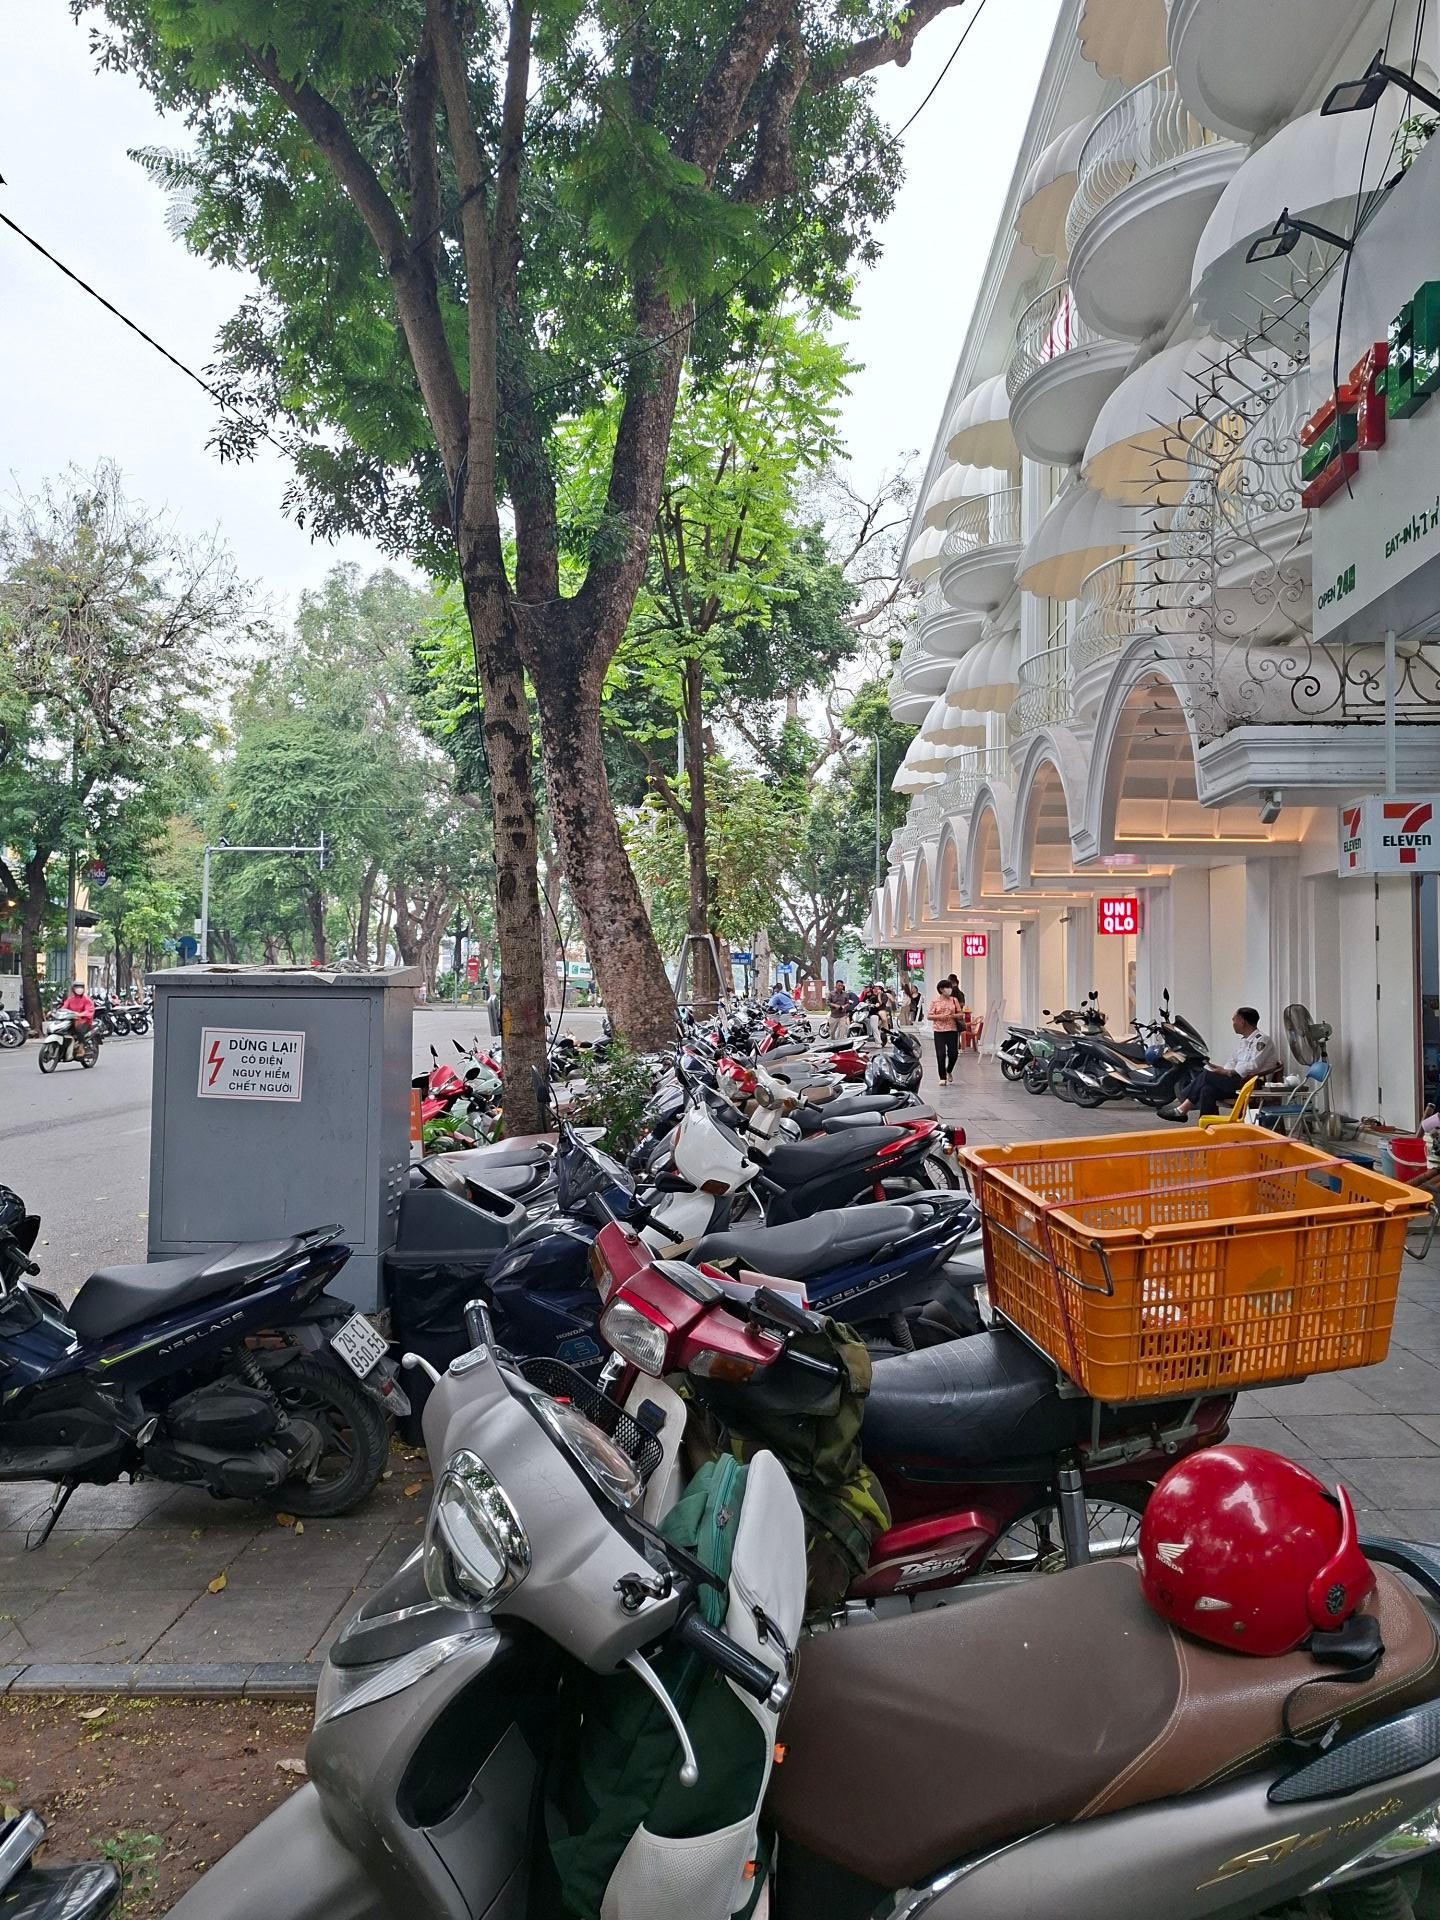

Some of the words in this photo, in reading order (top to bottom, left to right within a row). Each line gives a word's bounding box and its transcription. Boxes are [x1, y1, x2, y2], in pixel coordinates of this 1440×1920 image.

[1385, 523, 1412, 559] EAT-IN
[1317, 584, 1336, 610] OPEN
[1103, 901, 1132, 916] UNI
[1103, 916, 1134, 933] QLO
[966, 936, 983, 946] UNI
[966, 945, 985, 956] QLO
[908, 958, 922, 966] QLO
[229, 1037, 267, 1052] DỪNG
[272, 1041, 297, 1056] LẠI!
[241, 1054, 256, 1065] CÓ
[258, 1055, 283, 1067] ĐIỆN
[232, 1068, 262, 1078] NGUY
[264, 1066, 290, 1080] HIỂM
[228, 1079, 257, 1092] CHẾT
[259, 1081, 292, 1094] NGƯỜI
[158, 1310, 246, 1357] AIRBLADE
[338, 1319, 370, 1354] 29-C1
[555, 1327, 586, 1340] HONDA
[350, 1332, 386, 1374] 950.55
[1155, 1553, 1185, 1575] HONDA
